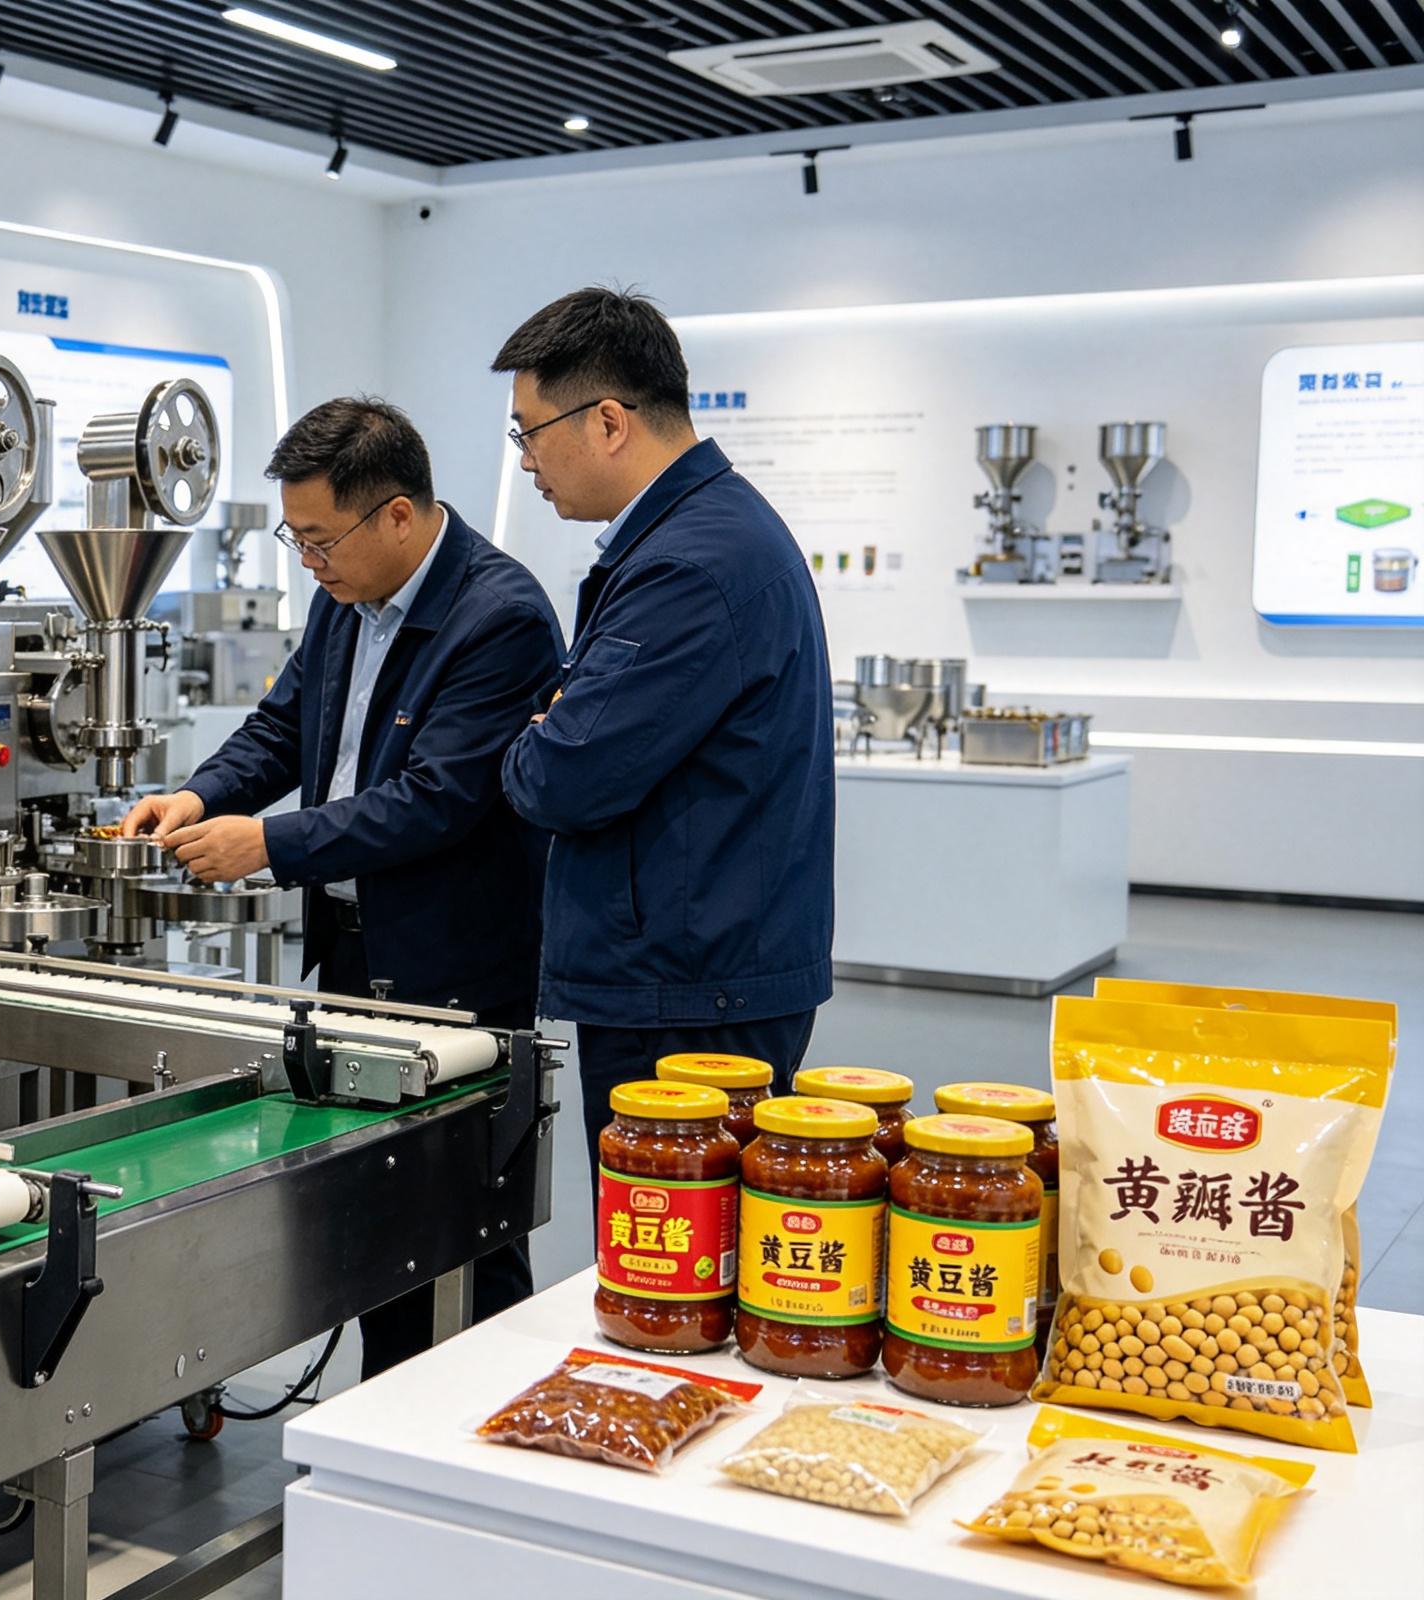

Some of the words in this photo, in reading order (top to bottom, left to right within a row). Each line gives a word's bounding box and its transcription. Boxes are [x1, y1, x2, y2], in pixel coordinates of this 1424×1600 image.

[608, 1209, 695, 1253] 黄豆酱
[759, 1234, 848, 1274] 黄豆酱
[907, 1255, 999, 1298] 黄豆酱
